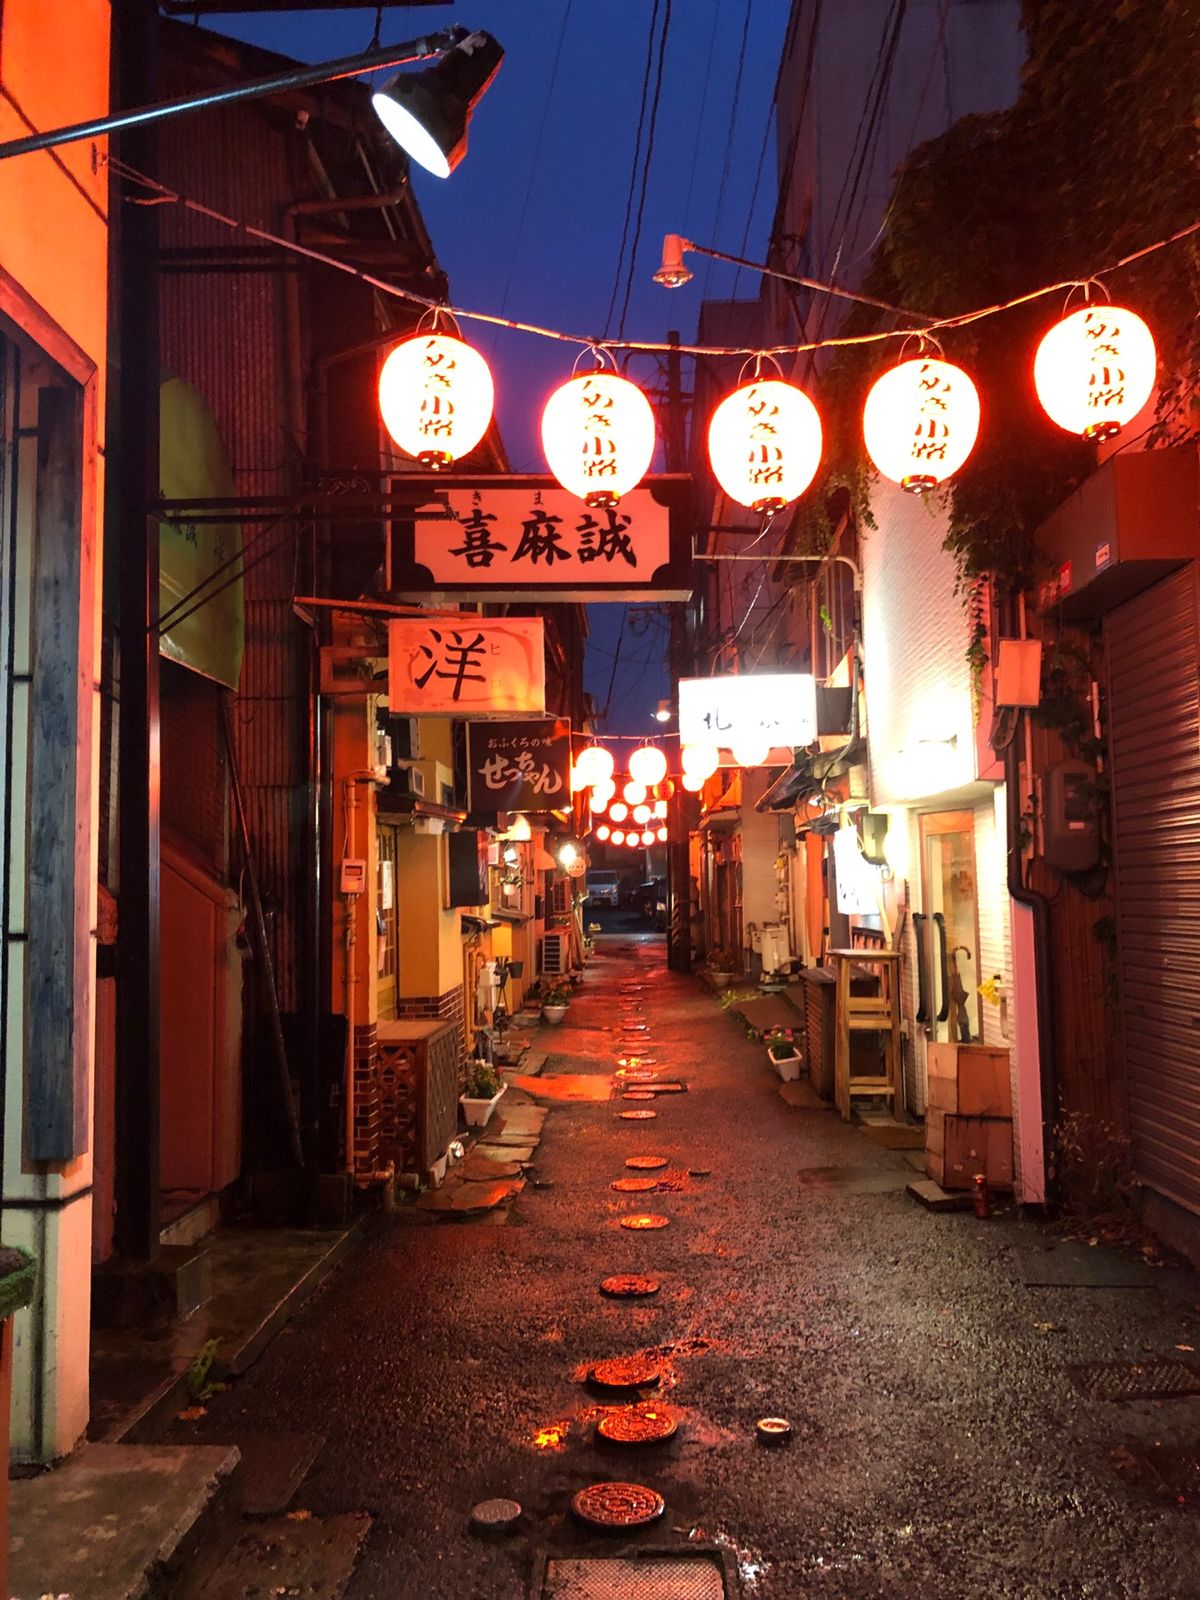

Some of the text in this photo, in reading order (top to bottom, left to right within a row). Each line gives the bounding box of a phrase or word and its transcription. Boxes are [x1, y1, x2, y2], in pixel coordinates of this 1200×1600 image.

[471, 490, 544, 505] き ま
[448, 509, 637, 568] 喜麻誠
[415, 628, 487, 702] 洋
[487, 737, 553, 749] おふくろの味
[477, 751, 563, 794] せっちゃん
